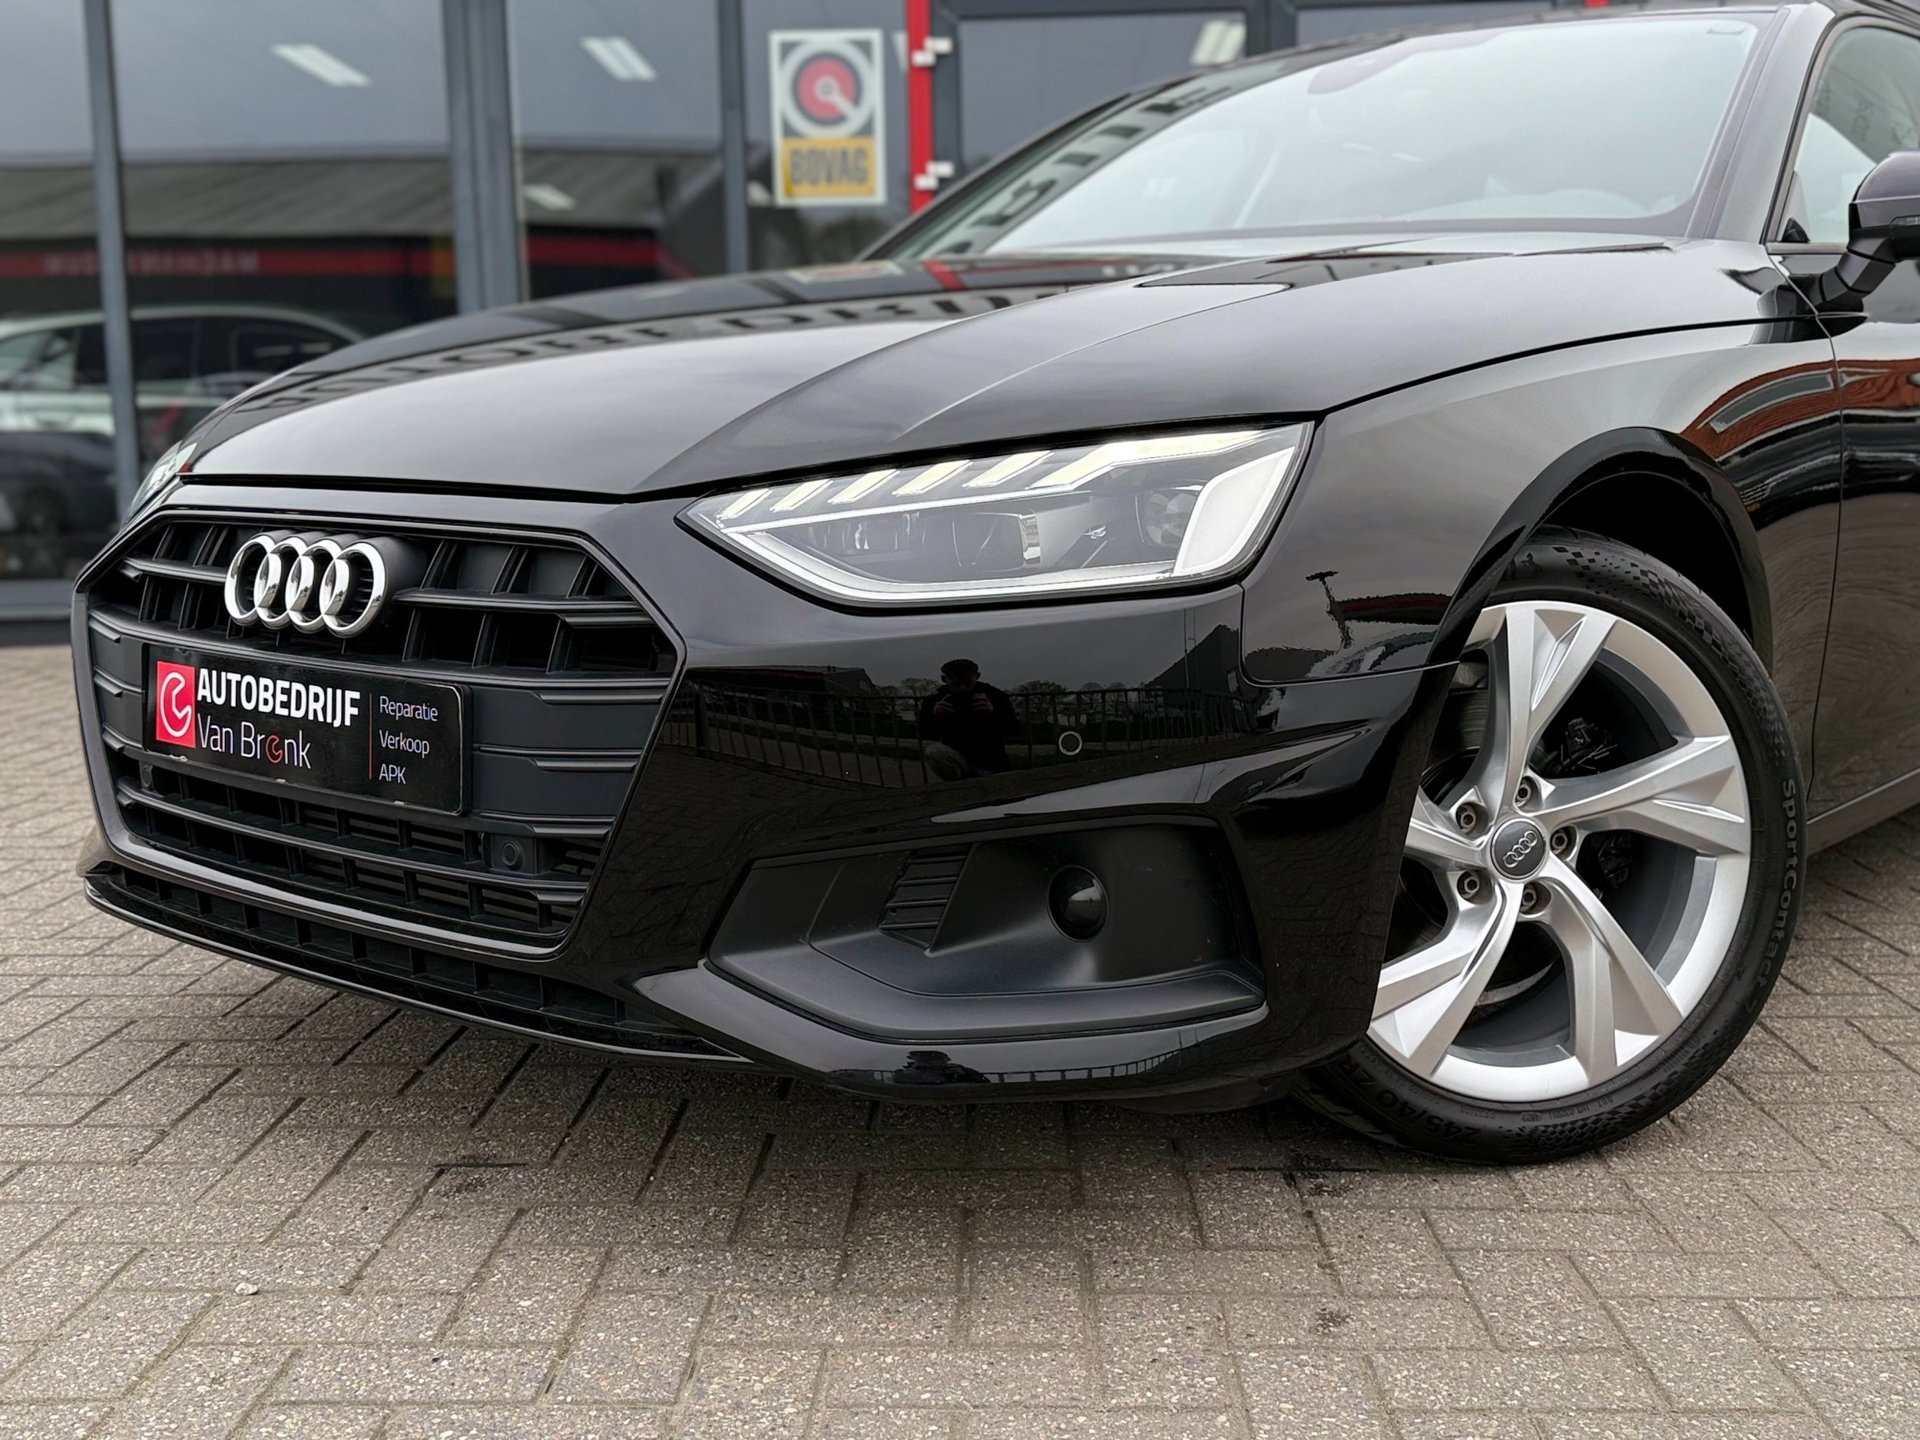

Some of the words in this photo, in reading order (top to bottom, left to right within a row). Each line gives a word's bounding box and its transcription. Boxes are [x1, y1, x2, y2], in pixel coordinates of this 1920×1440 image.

[790, 147, 869, 186] BOVAG
[197, 668, 361, 727] AUTOBEDRIJF
[379, 696, 439, 723] Reparatie
[197, 712, 234, 755] Van
[240, 721, 312, 770] Bronk
[379, 730, 431, 759] Verkoop
[379, 764, 407, 785] APK
[1756, 777, 1799, 989] SportContact
[1376, 1089, 1482, 1143] 245/40
